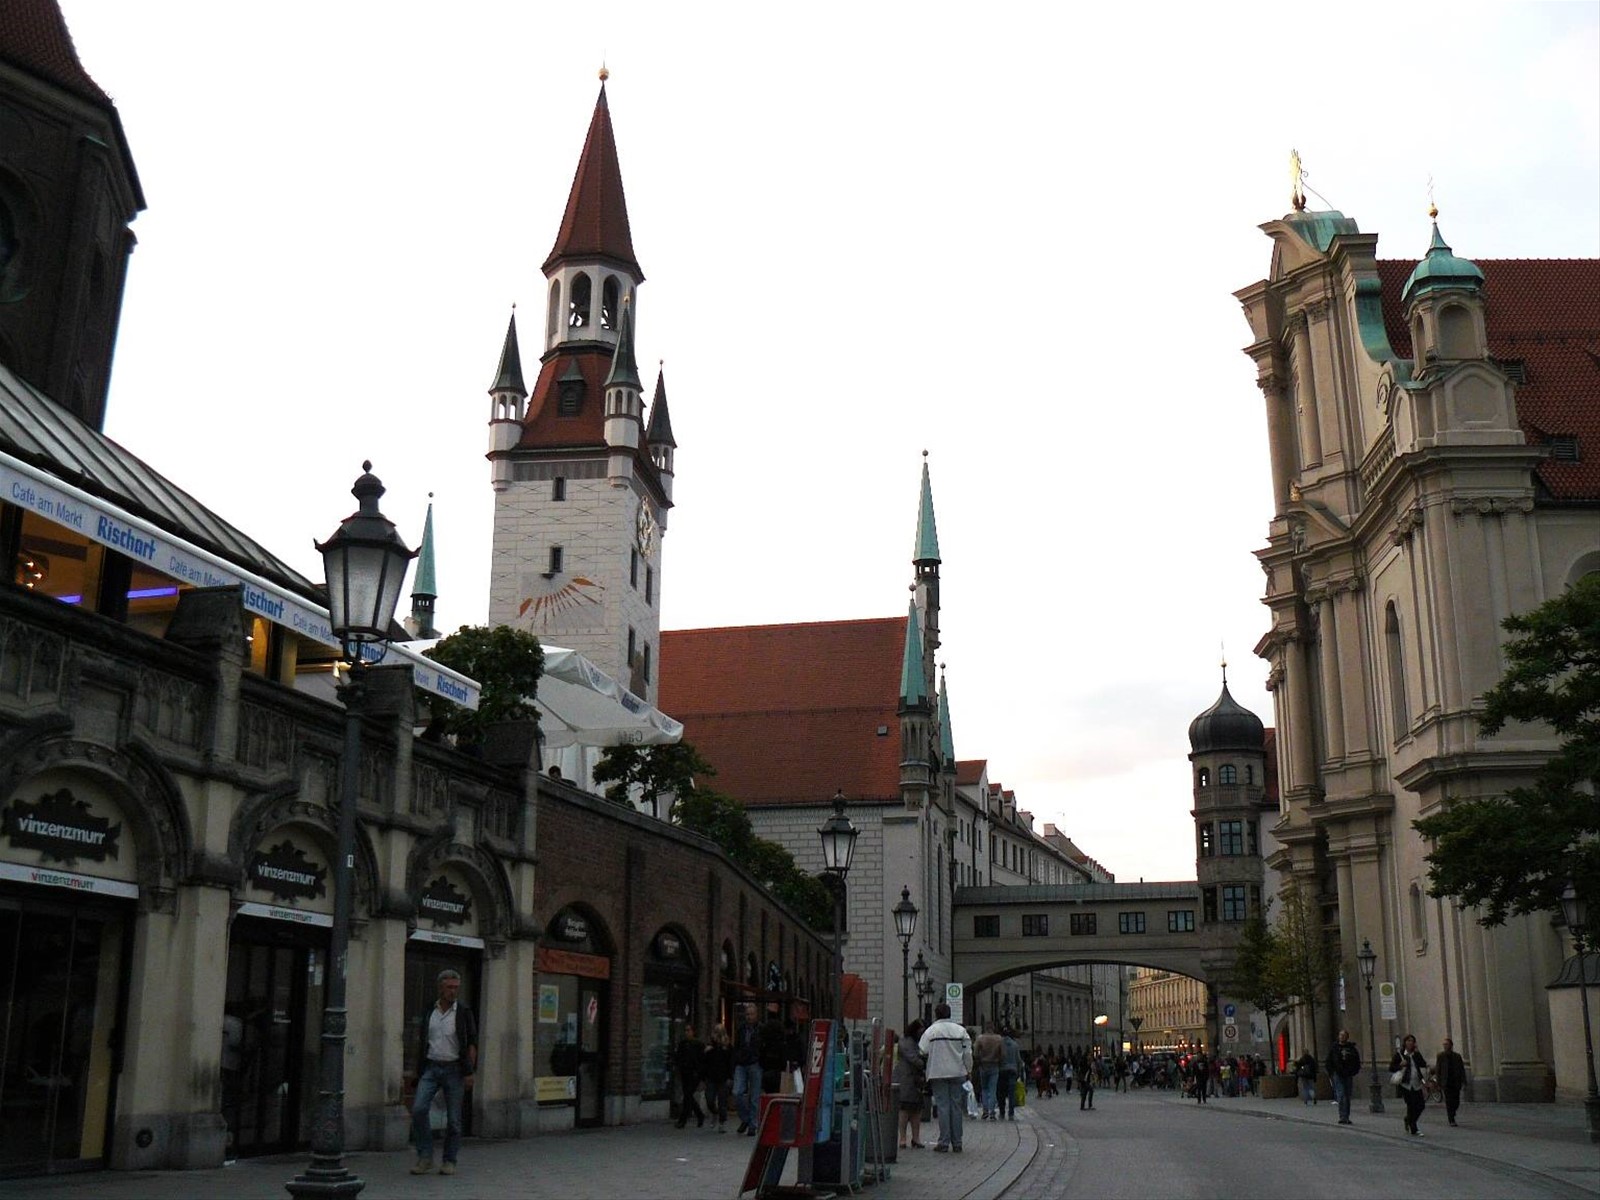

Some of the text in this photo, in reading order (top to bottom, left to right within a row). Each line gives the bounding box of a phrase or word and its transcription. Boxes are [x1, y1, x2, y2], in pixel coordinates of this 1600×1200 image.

[38, 496, 53, 514] am
[56, 501, 83, 529] Markt
[97, 515, 156, 560] Rischart
[436, 674, 468, 703] Rischart
[18, 813, 106, 845] vinzenzmurr
[31, 872, 94, 889] vinzenzmurr
[258, 861, 316, 886] vinzenzmurr
